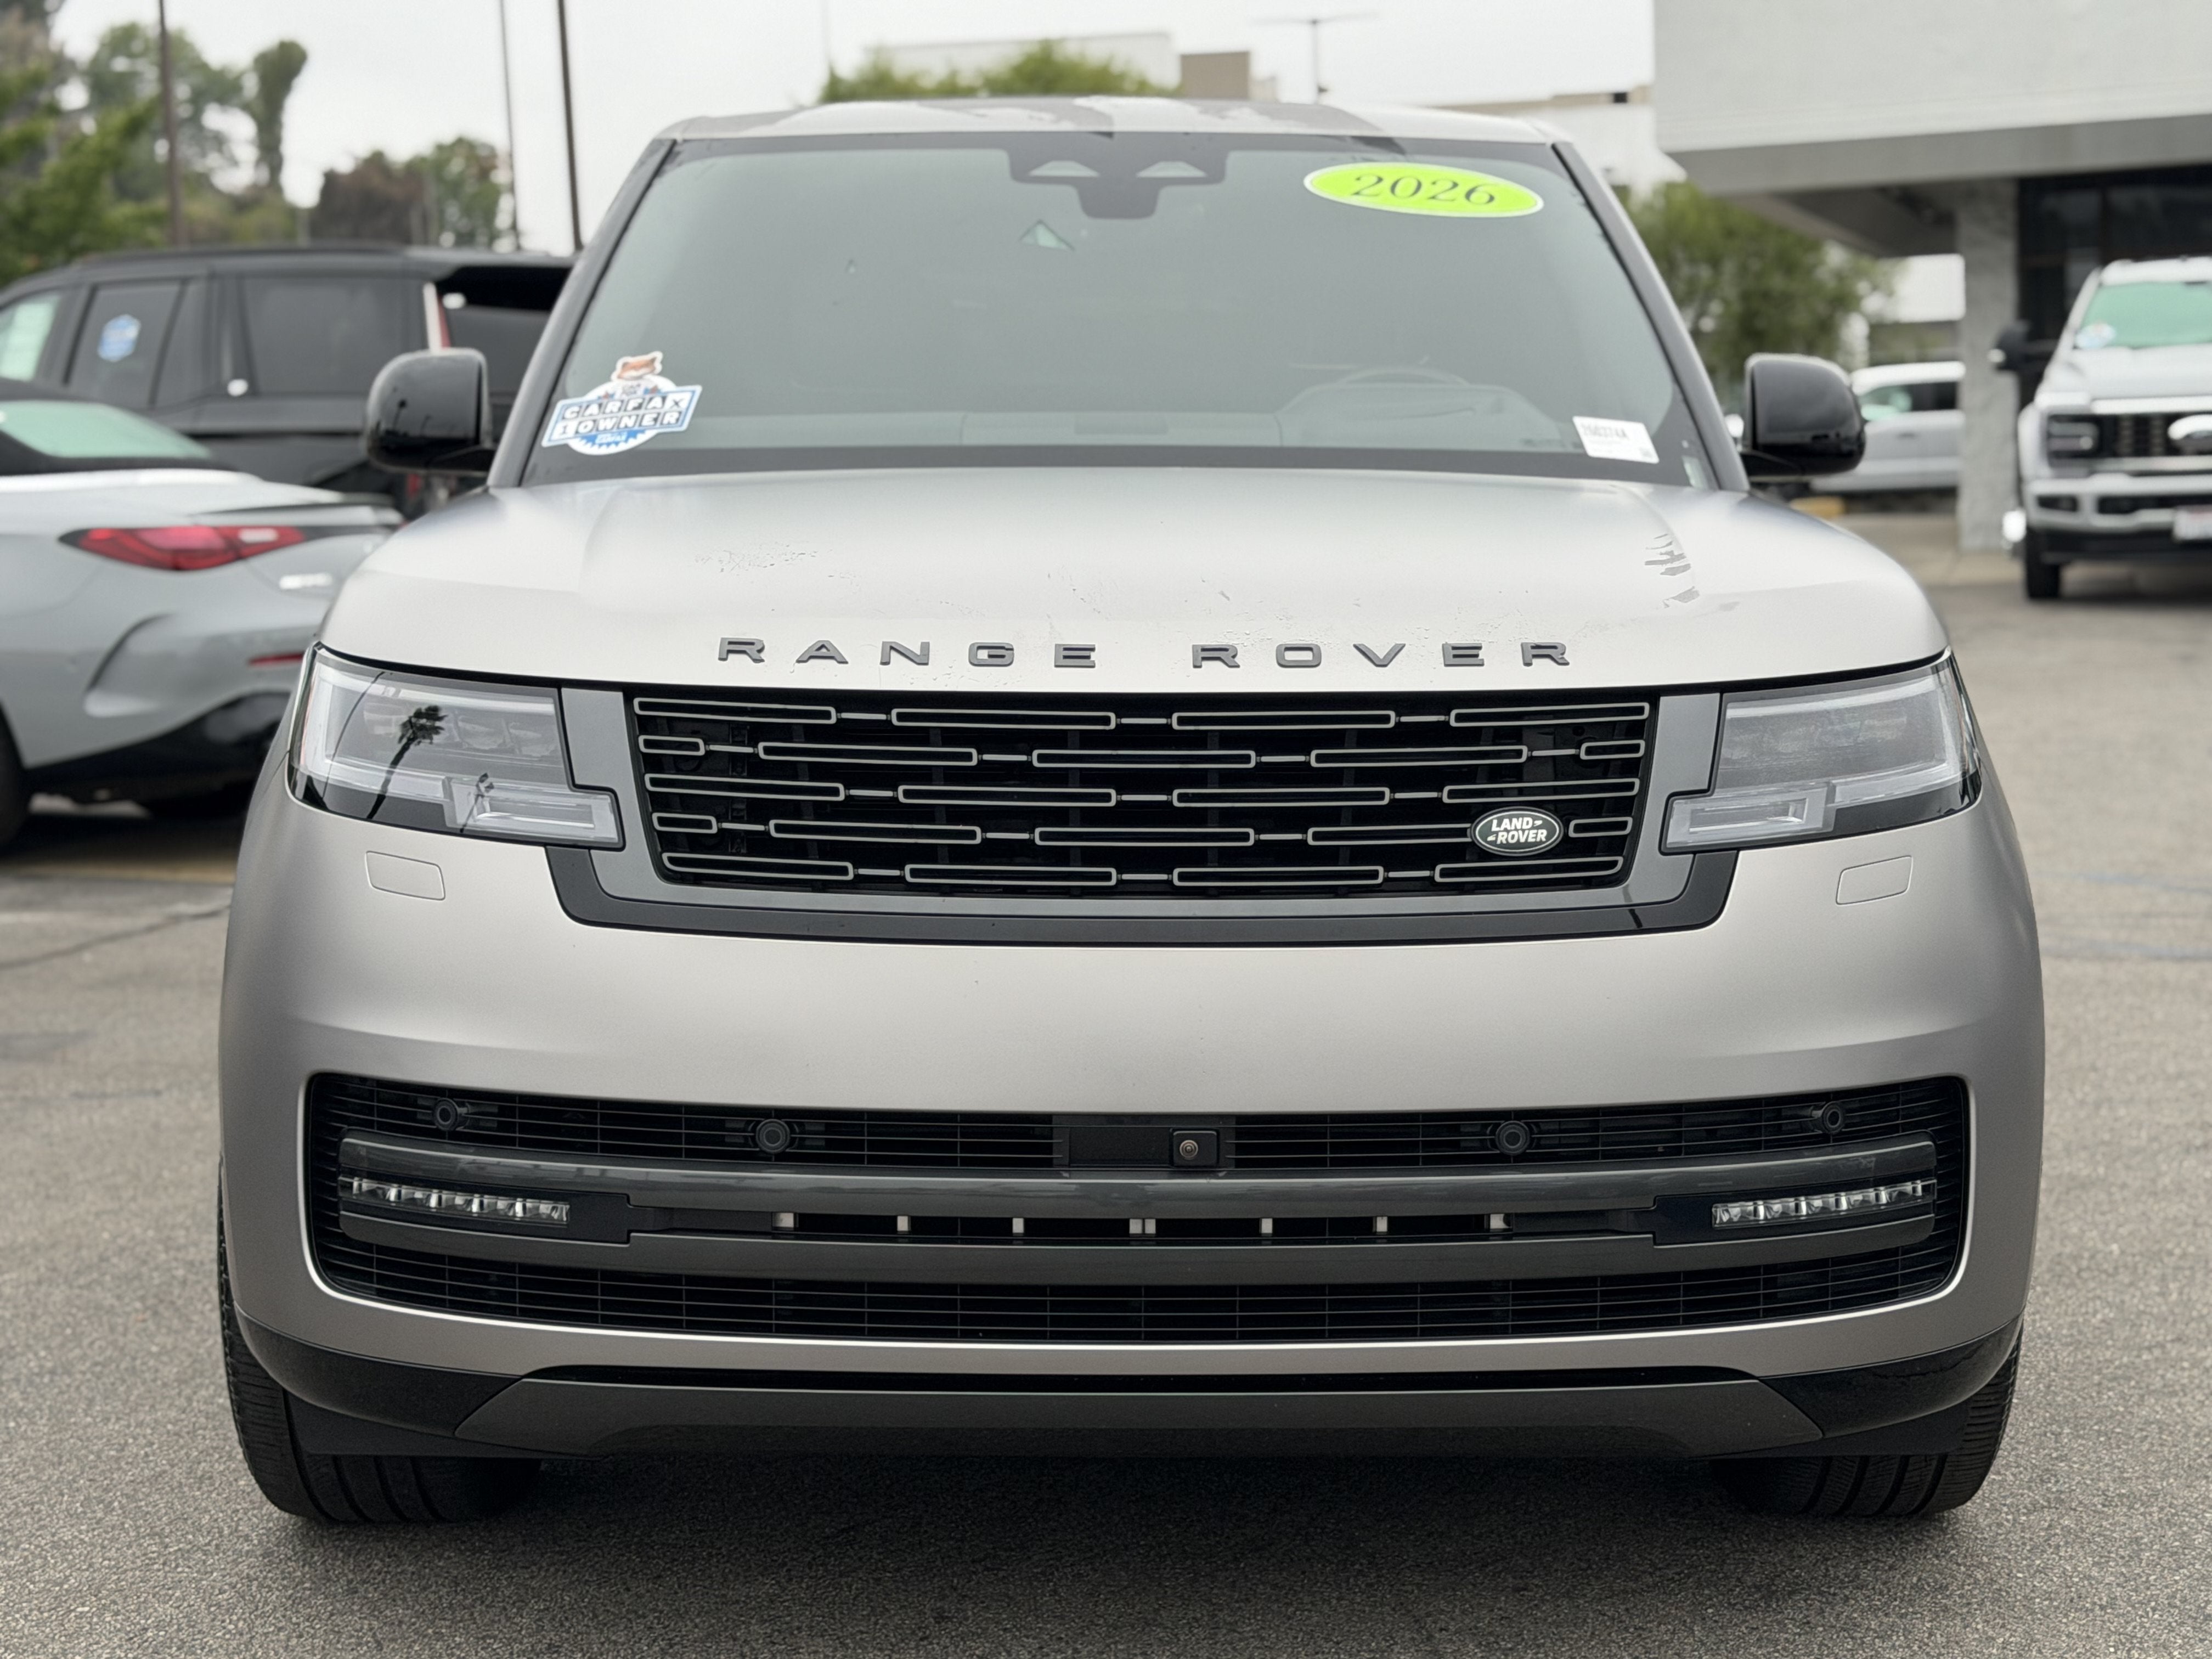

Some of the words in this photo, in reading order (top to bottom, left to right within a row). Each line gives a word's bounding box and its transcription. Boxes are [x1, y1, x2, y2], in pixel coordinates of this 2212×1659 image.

[1351, 173, 1496, 206] 2026
[563, 396, 686, 420] CARFAX
[577, 411, 680, 434] OWNER
[718, 637, 1096, 668] RANGE
[1192, 641, 1570, 668] ROVER
